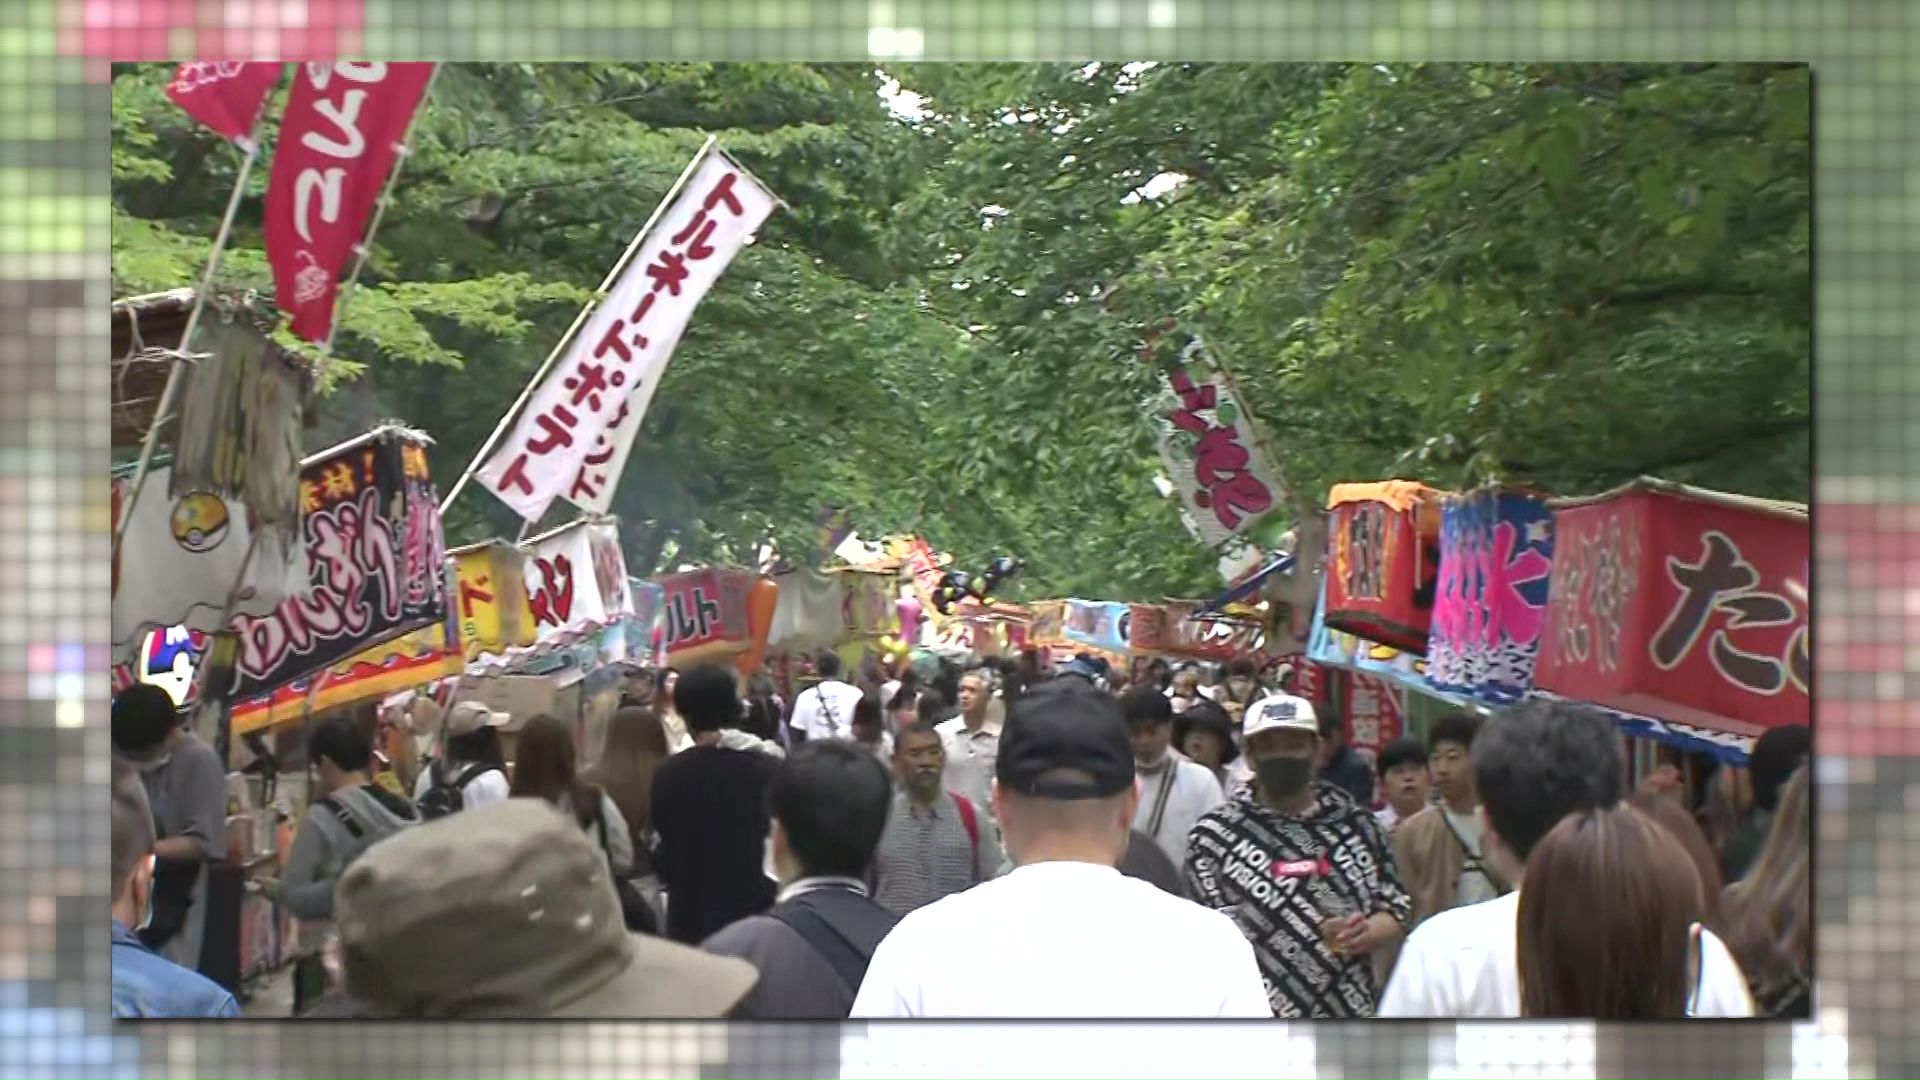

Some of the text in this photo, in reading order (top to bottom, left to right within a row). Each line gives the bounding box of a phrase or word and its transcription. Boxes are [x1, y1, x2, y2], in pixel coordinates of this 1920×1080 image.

[497, 172, 744, 496] トルネードポテト
[1649, 530, 1808, 696] た
[1222, 855, 1287, 910] VISION
